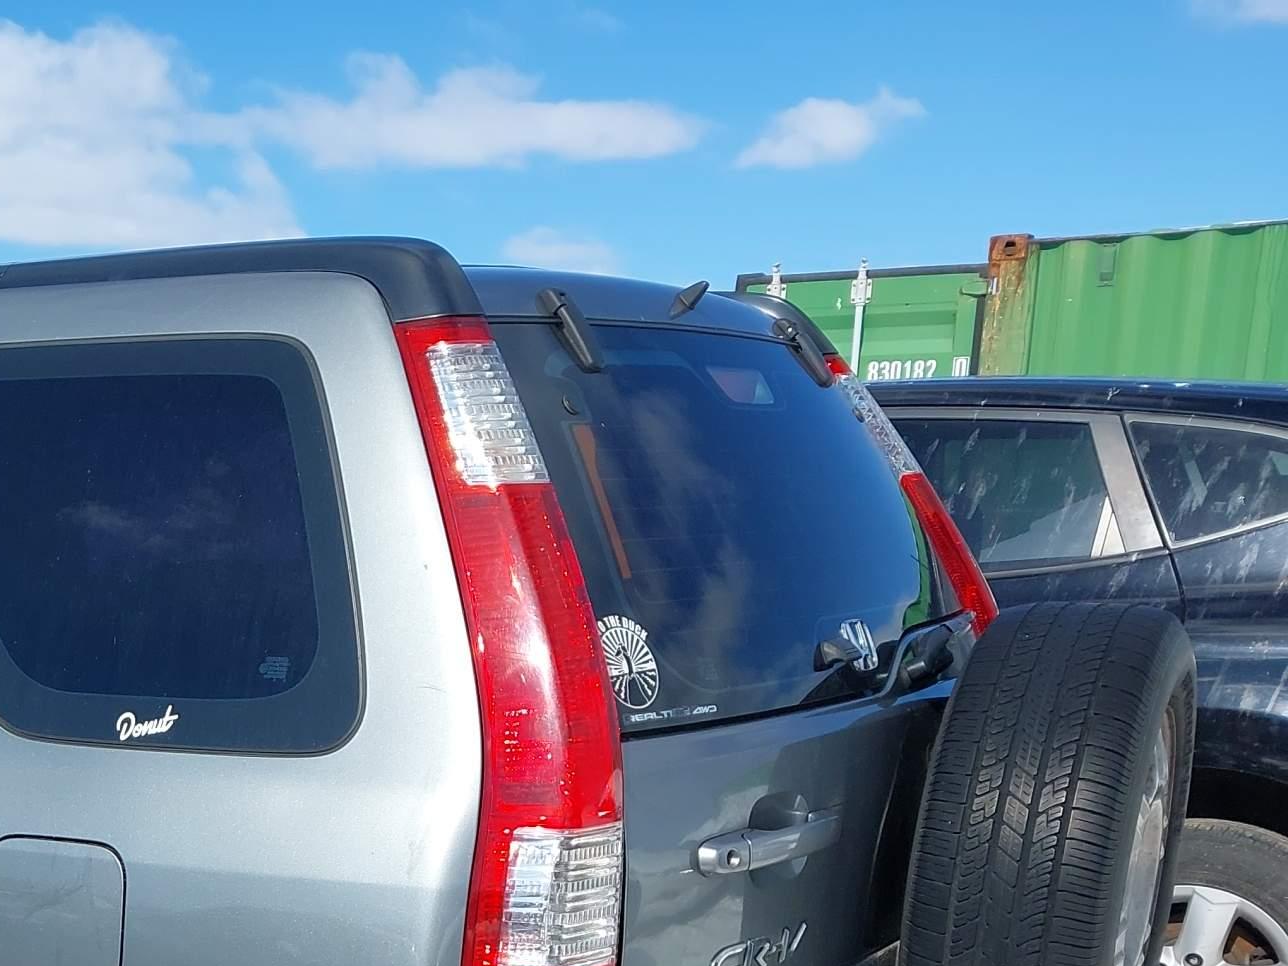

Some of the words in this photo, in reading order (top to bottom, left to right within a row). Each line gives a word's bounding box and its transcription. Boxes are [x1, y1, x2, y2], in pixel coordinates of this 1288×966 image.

[867, 360, 937, 380] 830182
[602, 614, 621, 629] THE
[621, 616, 648, 641] DUCK
[116, 704, 179, 741] Donut
